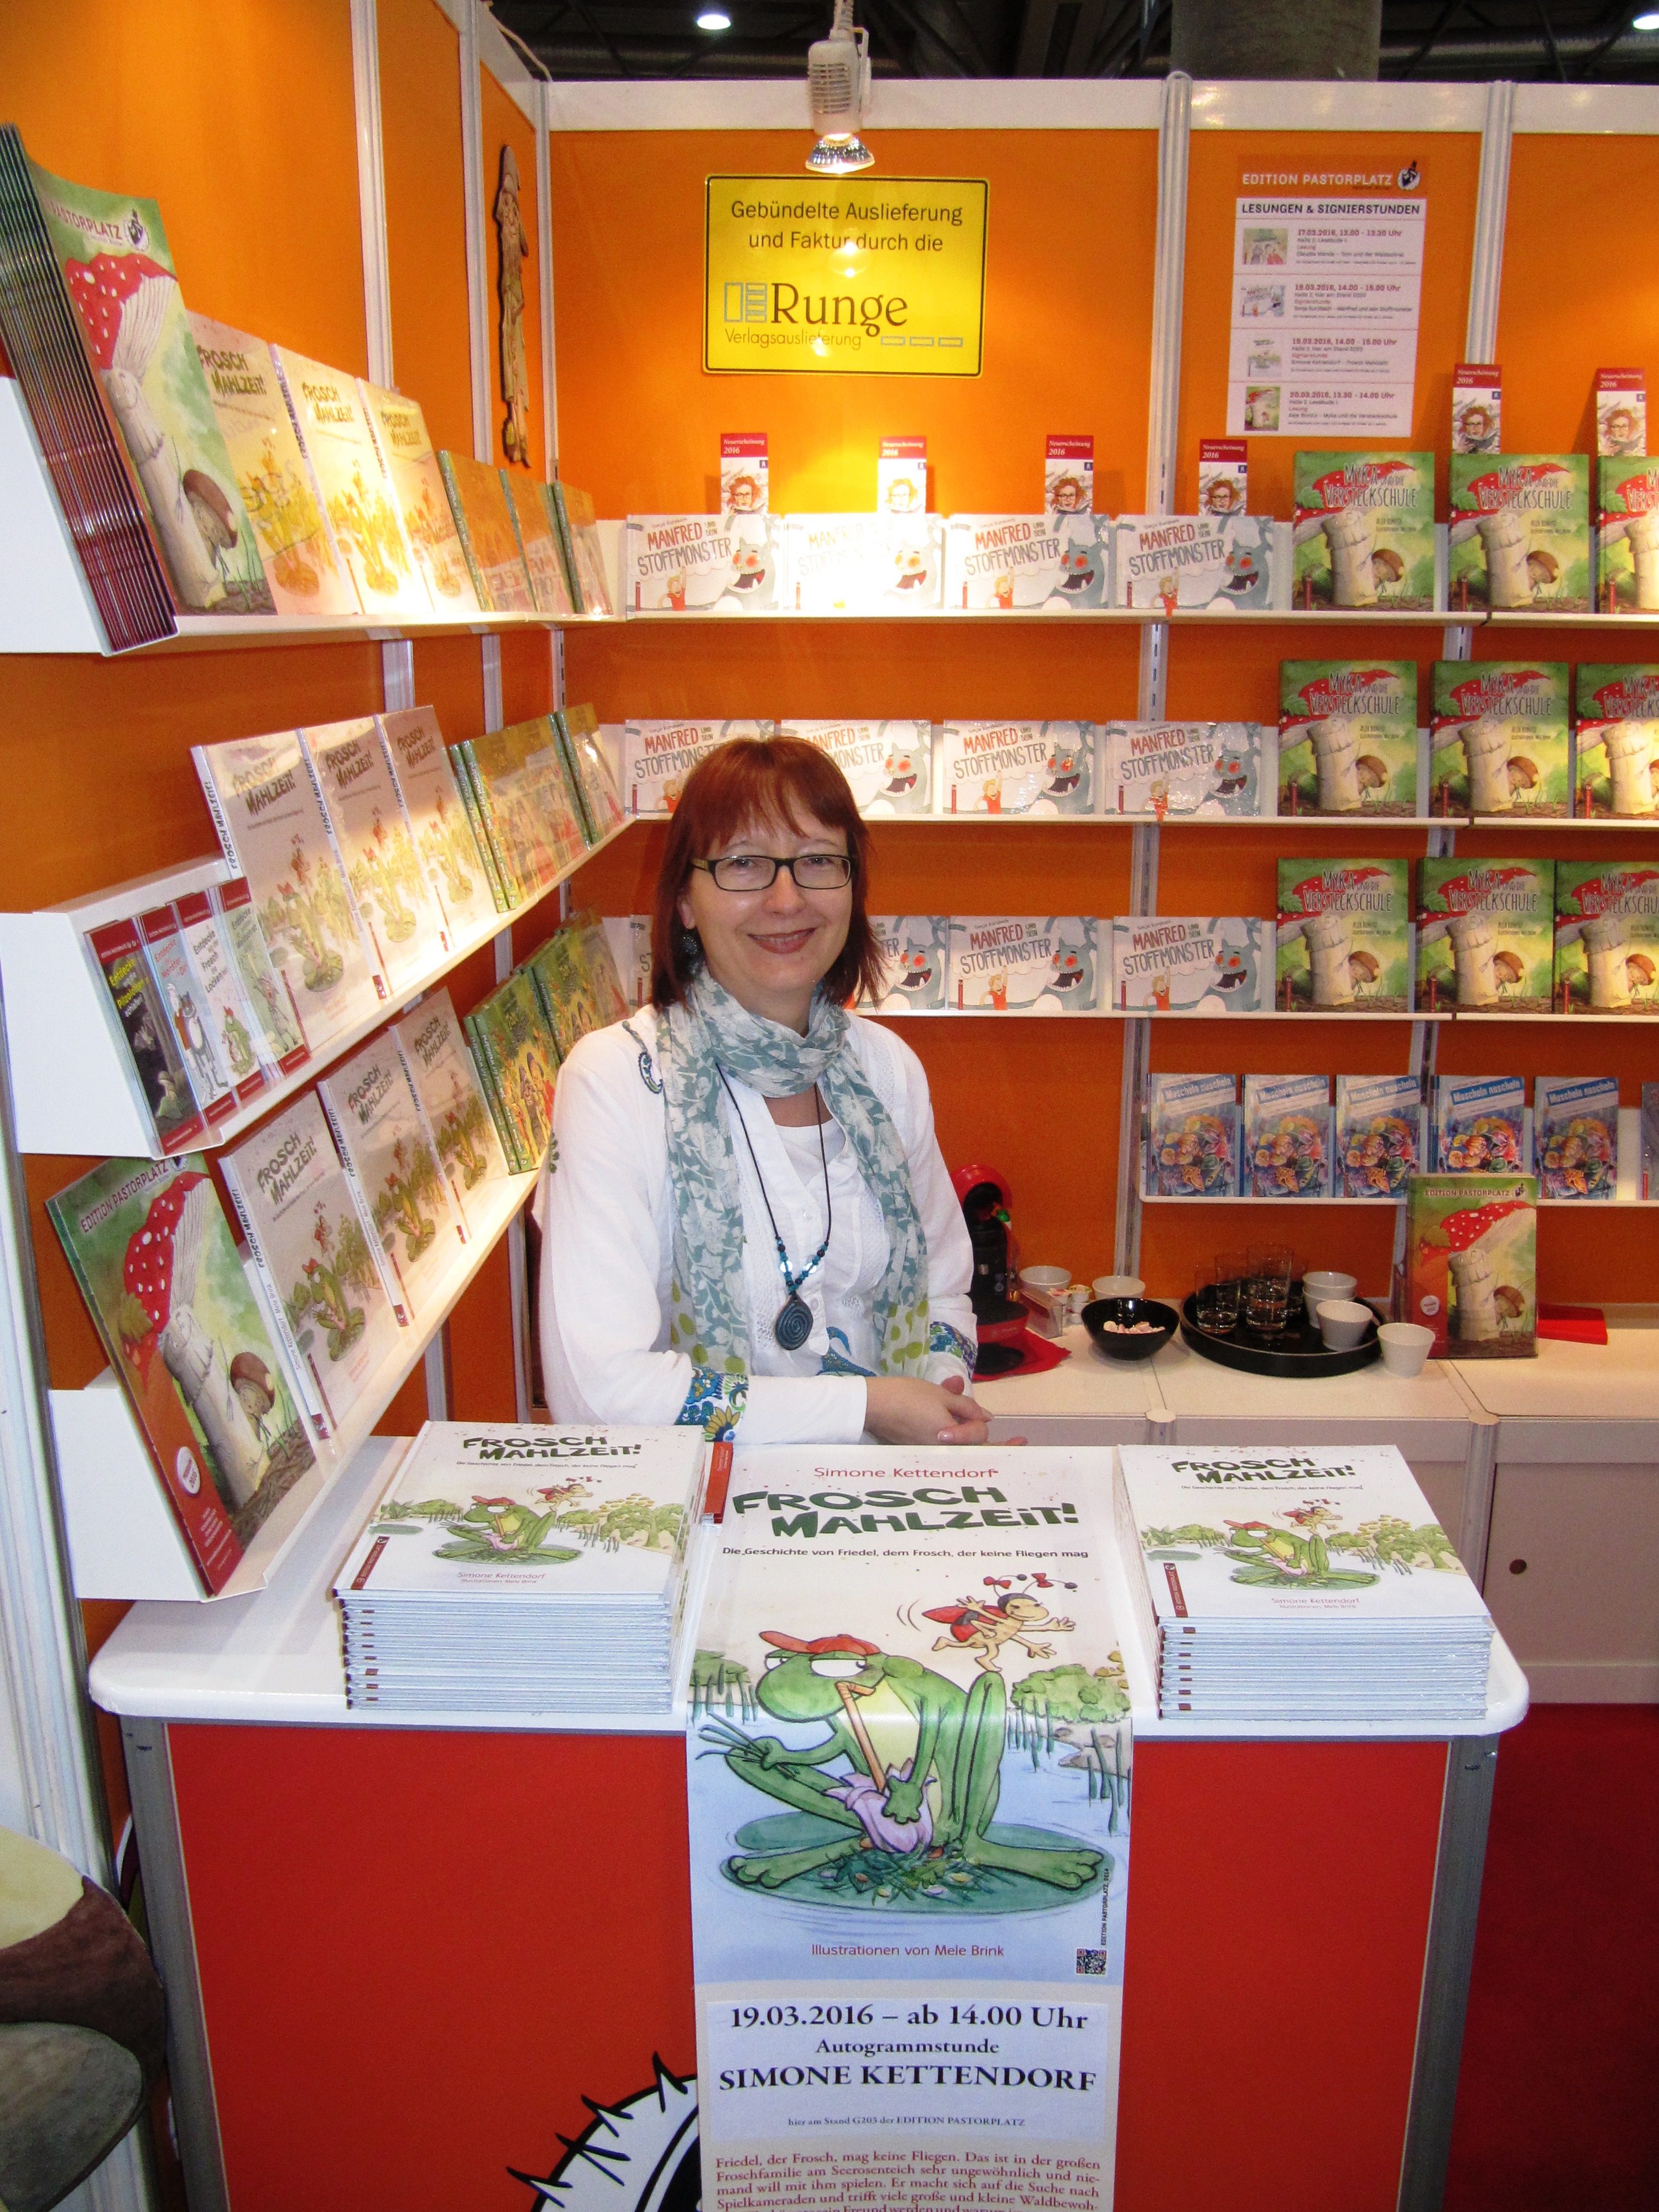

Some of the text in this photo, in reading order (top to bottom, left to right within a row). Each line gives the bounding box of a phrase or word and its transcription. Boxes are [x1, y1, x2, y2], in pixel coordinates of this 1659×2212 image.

[1243, 174, 1392, 186] EDITION PASTORPLATZ
[732, 201, 962, 226] Gebündelte Auslieferung
[1242, 204, 1420, 215] LESUNGEN & SIGNIERSTUNDEN
[749, 231, 943, 251] und Faktur durch die
[771, 283, 907, 337] Runge
[725, 328, 861, 350] Verlagsauslieferung
[196, 345, 248, 371] FROSCH
[301, 382, 341, 404] FROSCH
[723, 446, 740, 455] 2016
[1344, 463, 1379, 488] MYKA
[1499, 465, 1533, 488] MYKA
[1324, 482, 1416, 509] VERSTECKSCHULE
[1479, 485, 1571, 510] VERSTECKSCHULE
[647, 523, 703, 551] MANFRED
[975, 523, 1031, 551] MANFRED
[637, 538, 732, 576] STOFFMONSTER
[964, 538, 1061, 576] STOFFMONSTER
[644, 728, 698, 756] MANFRED
[963, 728, 1018, 755] MANFRED
[325, 740, 361, 771] FROSCH
[953, 742, 1047, 779] STOFFMONSTER
[1322, 870, 1355, 891] MYKA
[1303, 890, 1392, 911] VERSTECKSCHULE
[970, 924, 1024, 951] MANFRED
[1133, 924, 1187, 951] MANFRED
[960, 938, 1051, 974] STOFFMONSTER
[1123, 940, 1214, 976] STOFFMONSTER
[348, 1065, 381, 1113] FROSCH
[257, 1133, 302, 1193] FROSCH
[81, 1161, 169, 1233] EDITION PASTORPLATZ
[463, 1436, 608, 1449] FROSCH
[814, 1468, 995, 1478] Simone Kettendorf
[1171, 1458, 1316, 1473] FROSCH
[732, 1486, 1008, 1514] FROSCH
[811, 1944, 1004, 1957] Illustrationen von Mele Brink
[731, 2004, 873, 2028] 19.03.2016
[907, 2004, 938, 2025] ab
[950, 2004, 1021, 2026] 14.00
[1031, 2006, 1088, 2029] Uhr
[815, 2038, 1000, 2058] Autogrammstunde
[719, 2065, 1097, 2091] SIMONE KETTENDORF
[788, 2117, 806, 2126] hier
[824, 2117, 850, 2125] Stand
[896, 2116, 945, 2125] EDITION
[948, 2116, 1025, 2126] PASTORPLATZ
[716, 2150, 1100, 2170] Friedel, der Frosch, mag keine Fliegen. Das ist in der großen
[716, 2167, 802, 2183] Froschfamilie
[831, 2164, 915, 2176] Seerosenteich
[920, 2164, 947, 2174] sehr
[951, 2166, 1040, 2178] ungewöhnlich
[1046, 2171, 1071, 2181] und
[1076, 2173, 1100, 2183] nie-
[717, 2178, 1099, 2198] mand will mit ihm spielen. Er macht sich auf die Suche nach
[717, 2190, 1098, 2211] Spielkameraden und trifft viele große und kleine Waldbewoh-
